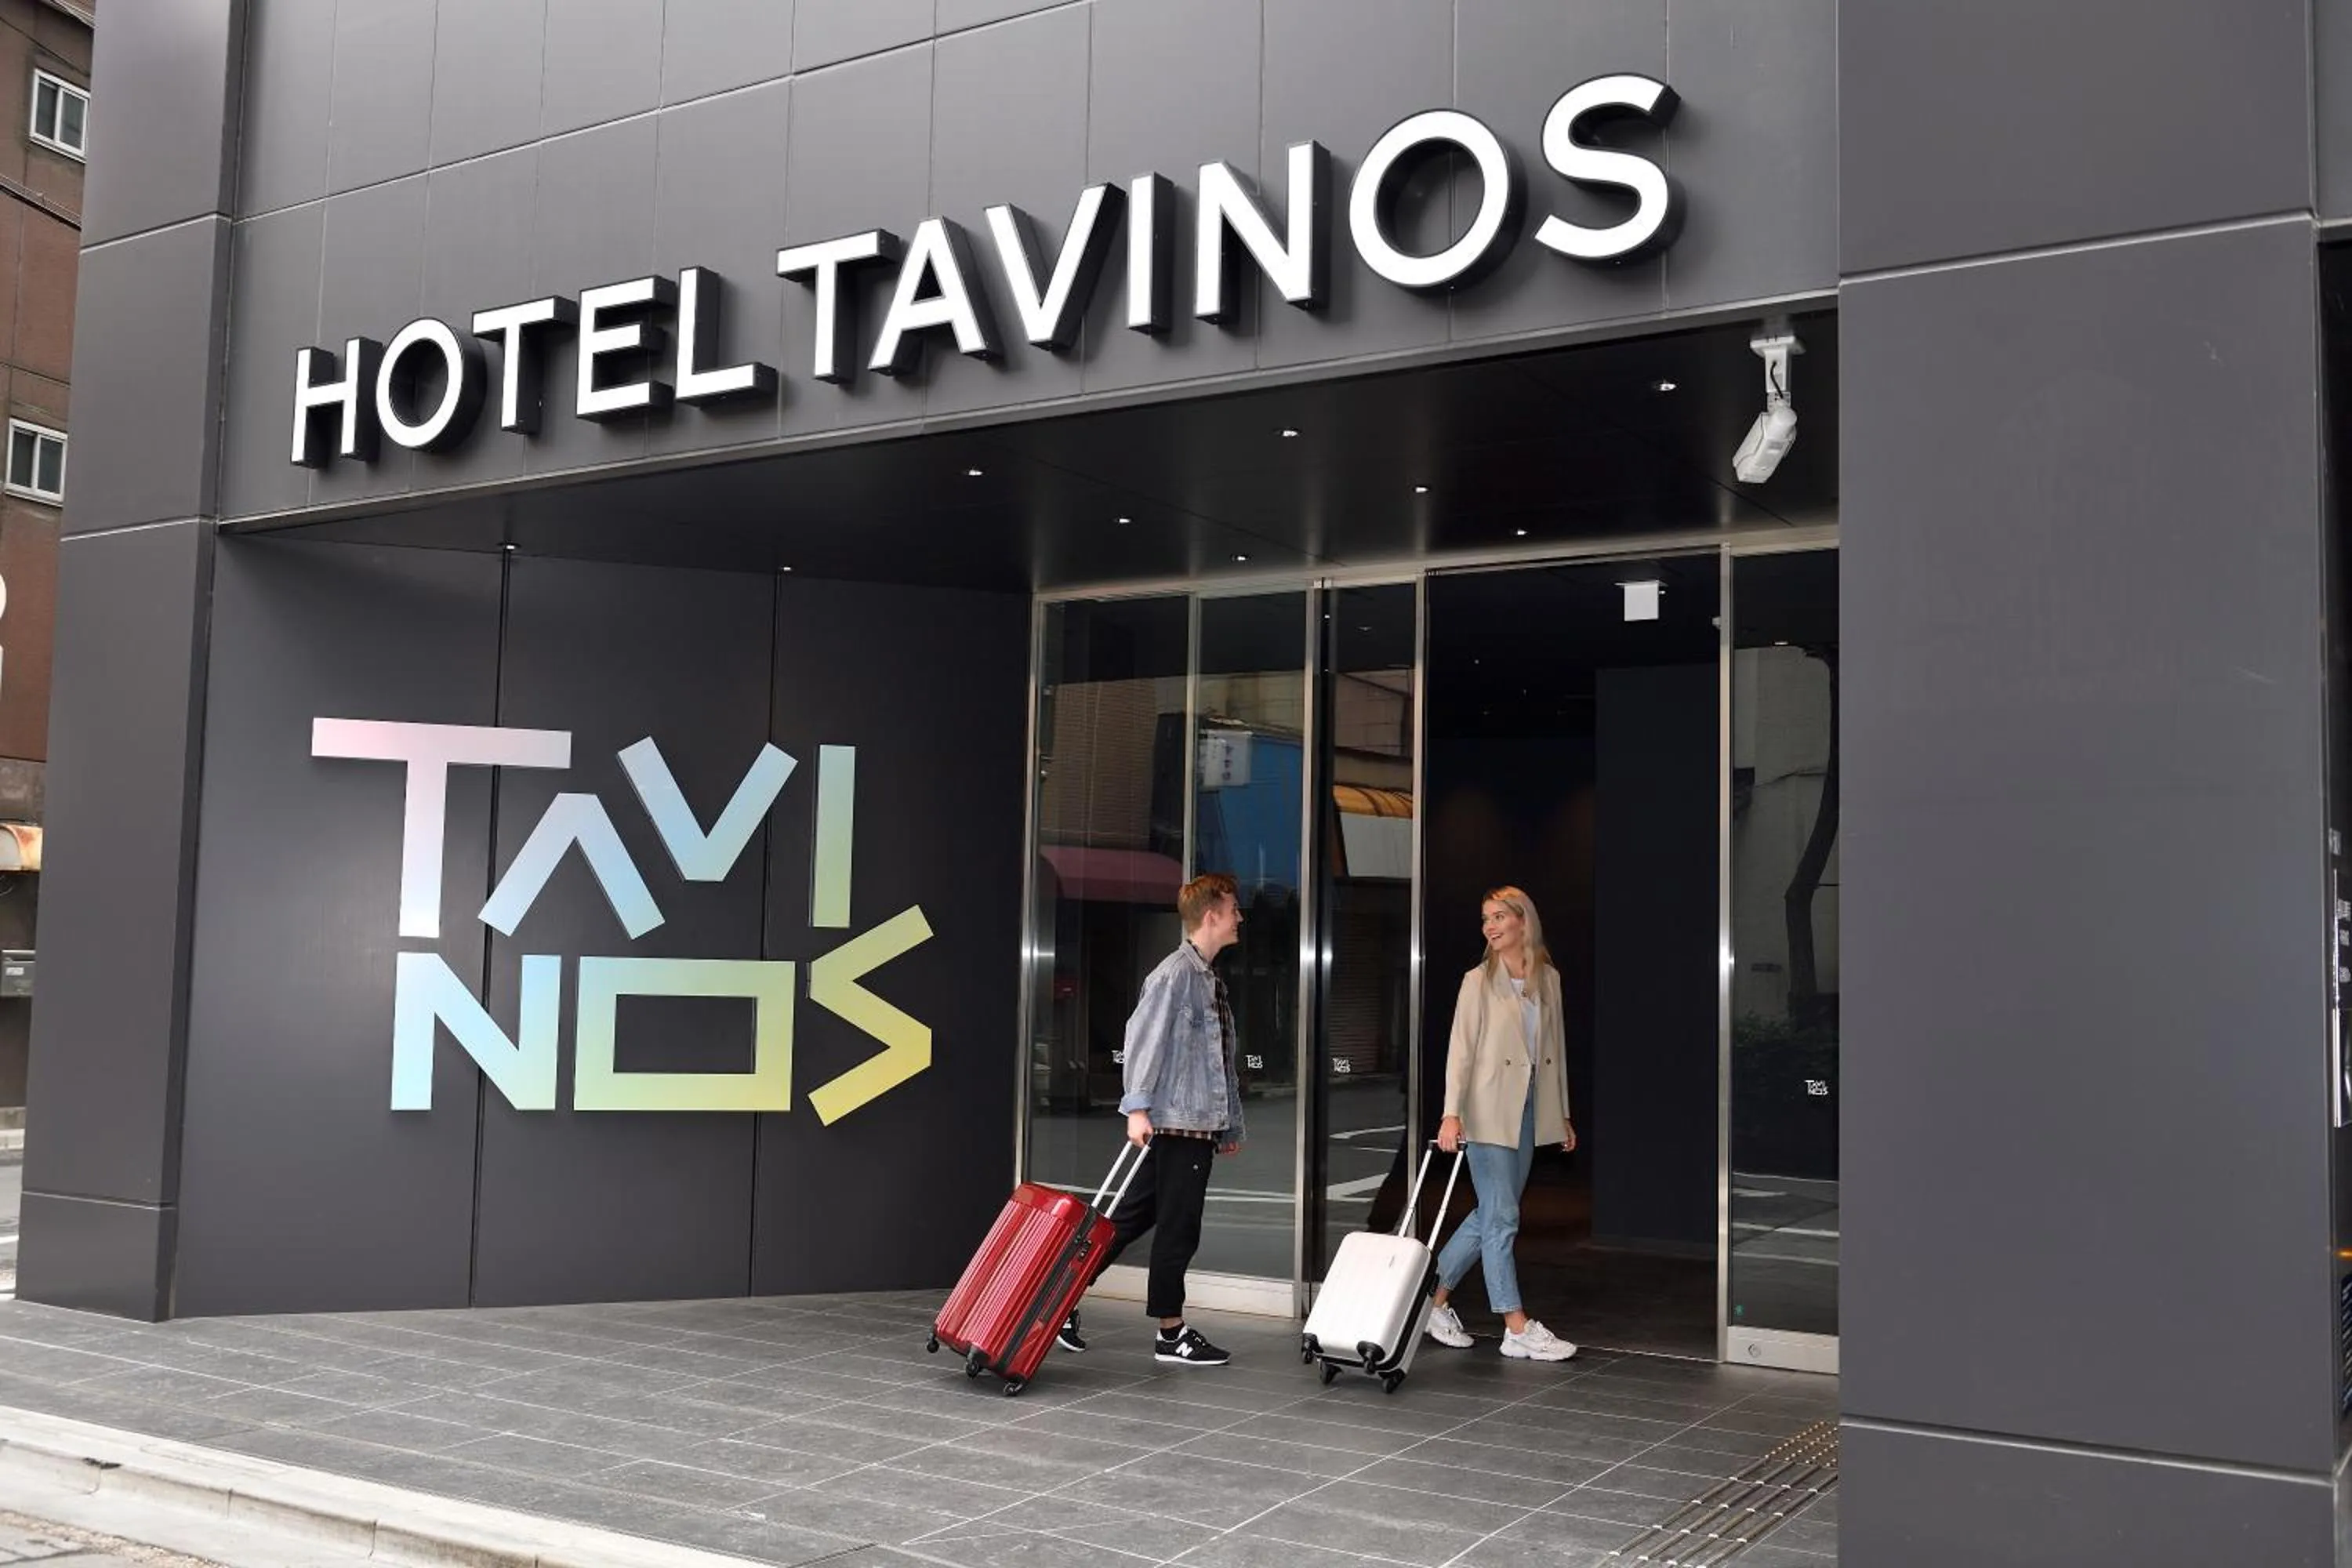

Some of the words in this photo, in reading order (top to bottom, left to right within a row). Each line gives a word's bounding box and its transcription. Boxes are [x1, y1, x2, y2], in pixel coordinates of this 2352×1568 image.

[290, 267, 767, 467] HOTEL
[775, 72, 1678, 383] TAVINOS
[311, 717, 855, 939] TAVI
[390, 905, 934, 1127] NOS
[1176, 1341, 1193, 1357] N
